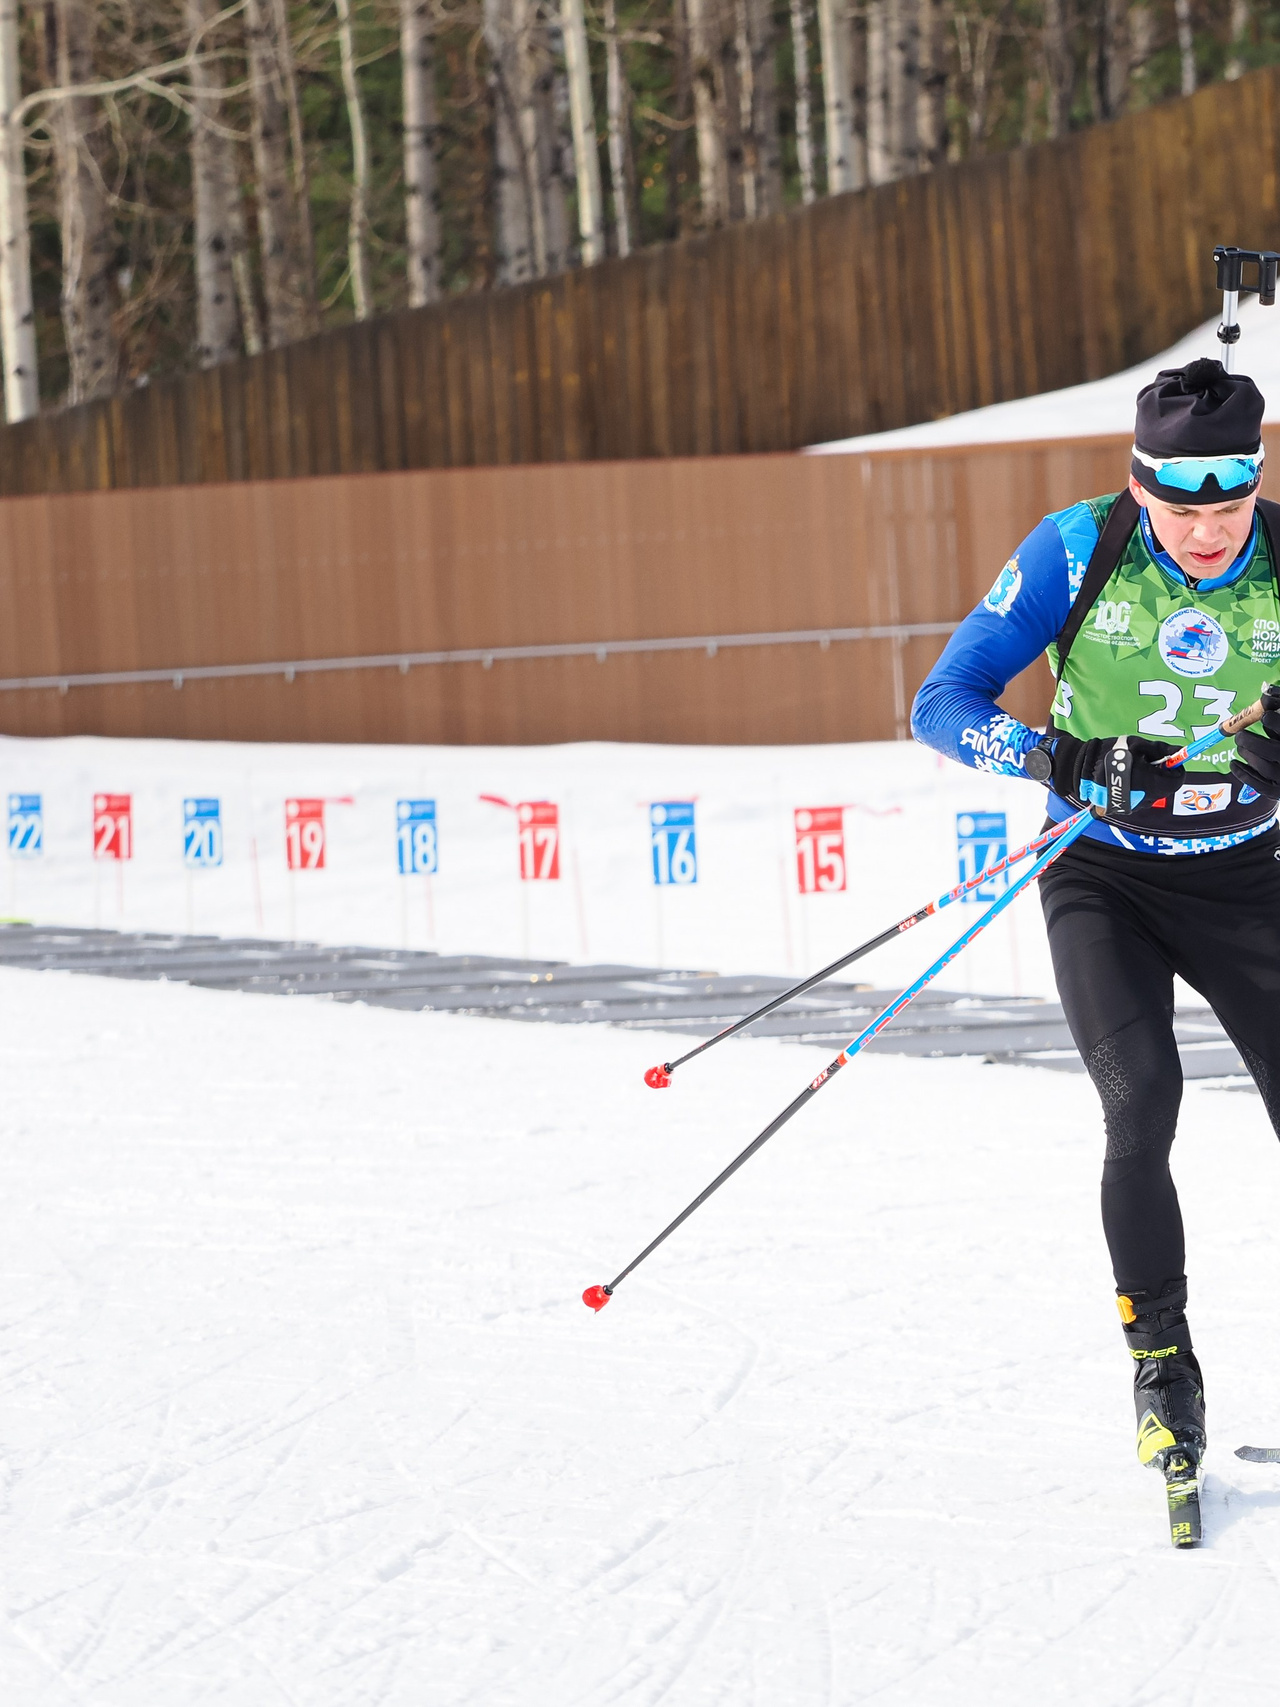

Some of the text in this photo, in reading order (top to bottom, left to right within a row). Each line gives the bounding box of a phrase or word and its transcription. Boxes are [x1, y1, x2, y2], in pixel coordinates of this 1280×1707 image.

[1165, 608, 1202, 626] ПЕРВЕНСТВО
[1138, 679, 1237, 743] 23
[1180, 789, 1213, 811] 20
[9, 815, 41, 850] 22
[95, 815, 130, 858] 21
[185, 819, 222, 864] 20
[287, 823, 324, 868] 19
[398, 824, 436, 873] 18
[521, 830, 557, 878] 17
[653, 830, 695, 884] 16
[798, 834, 845, 892] 15
[958, 842, 1009, 902] 14
